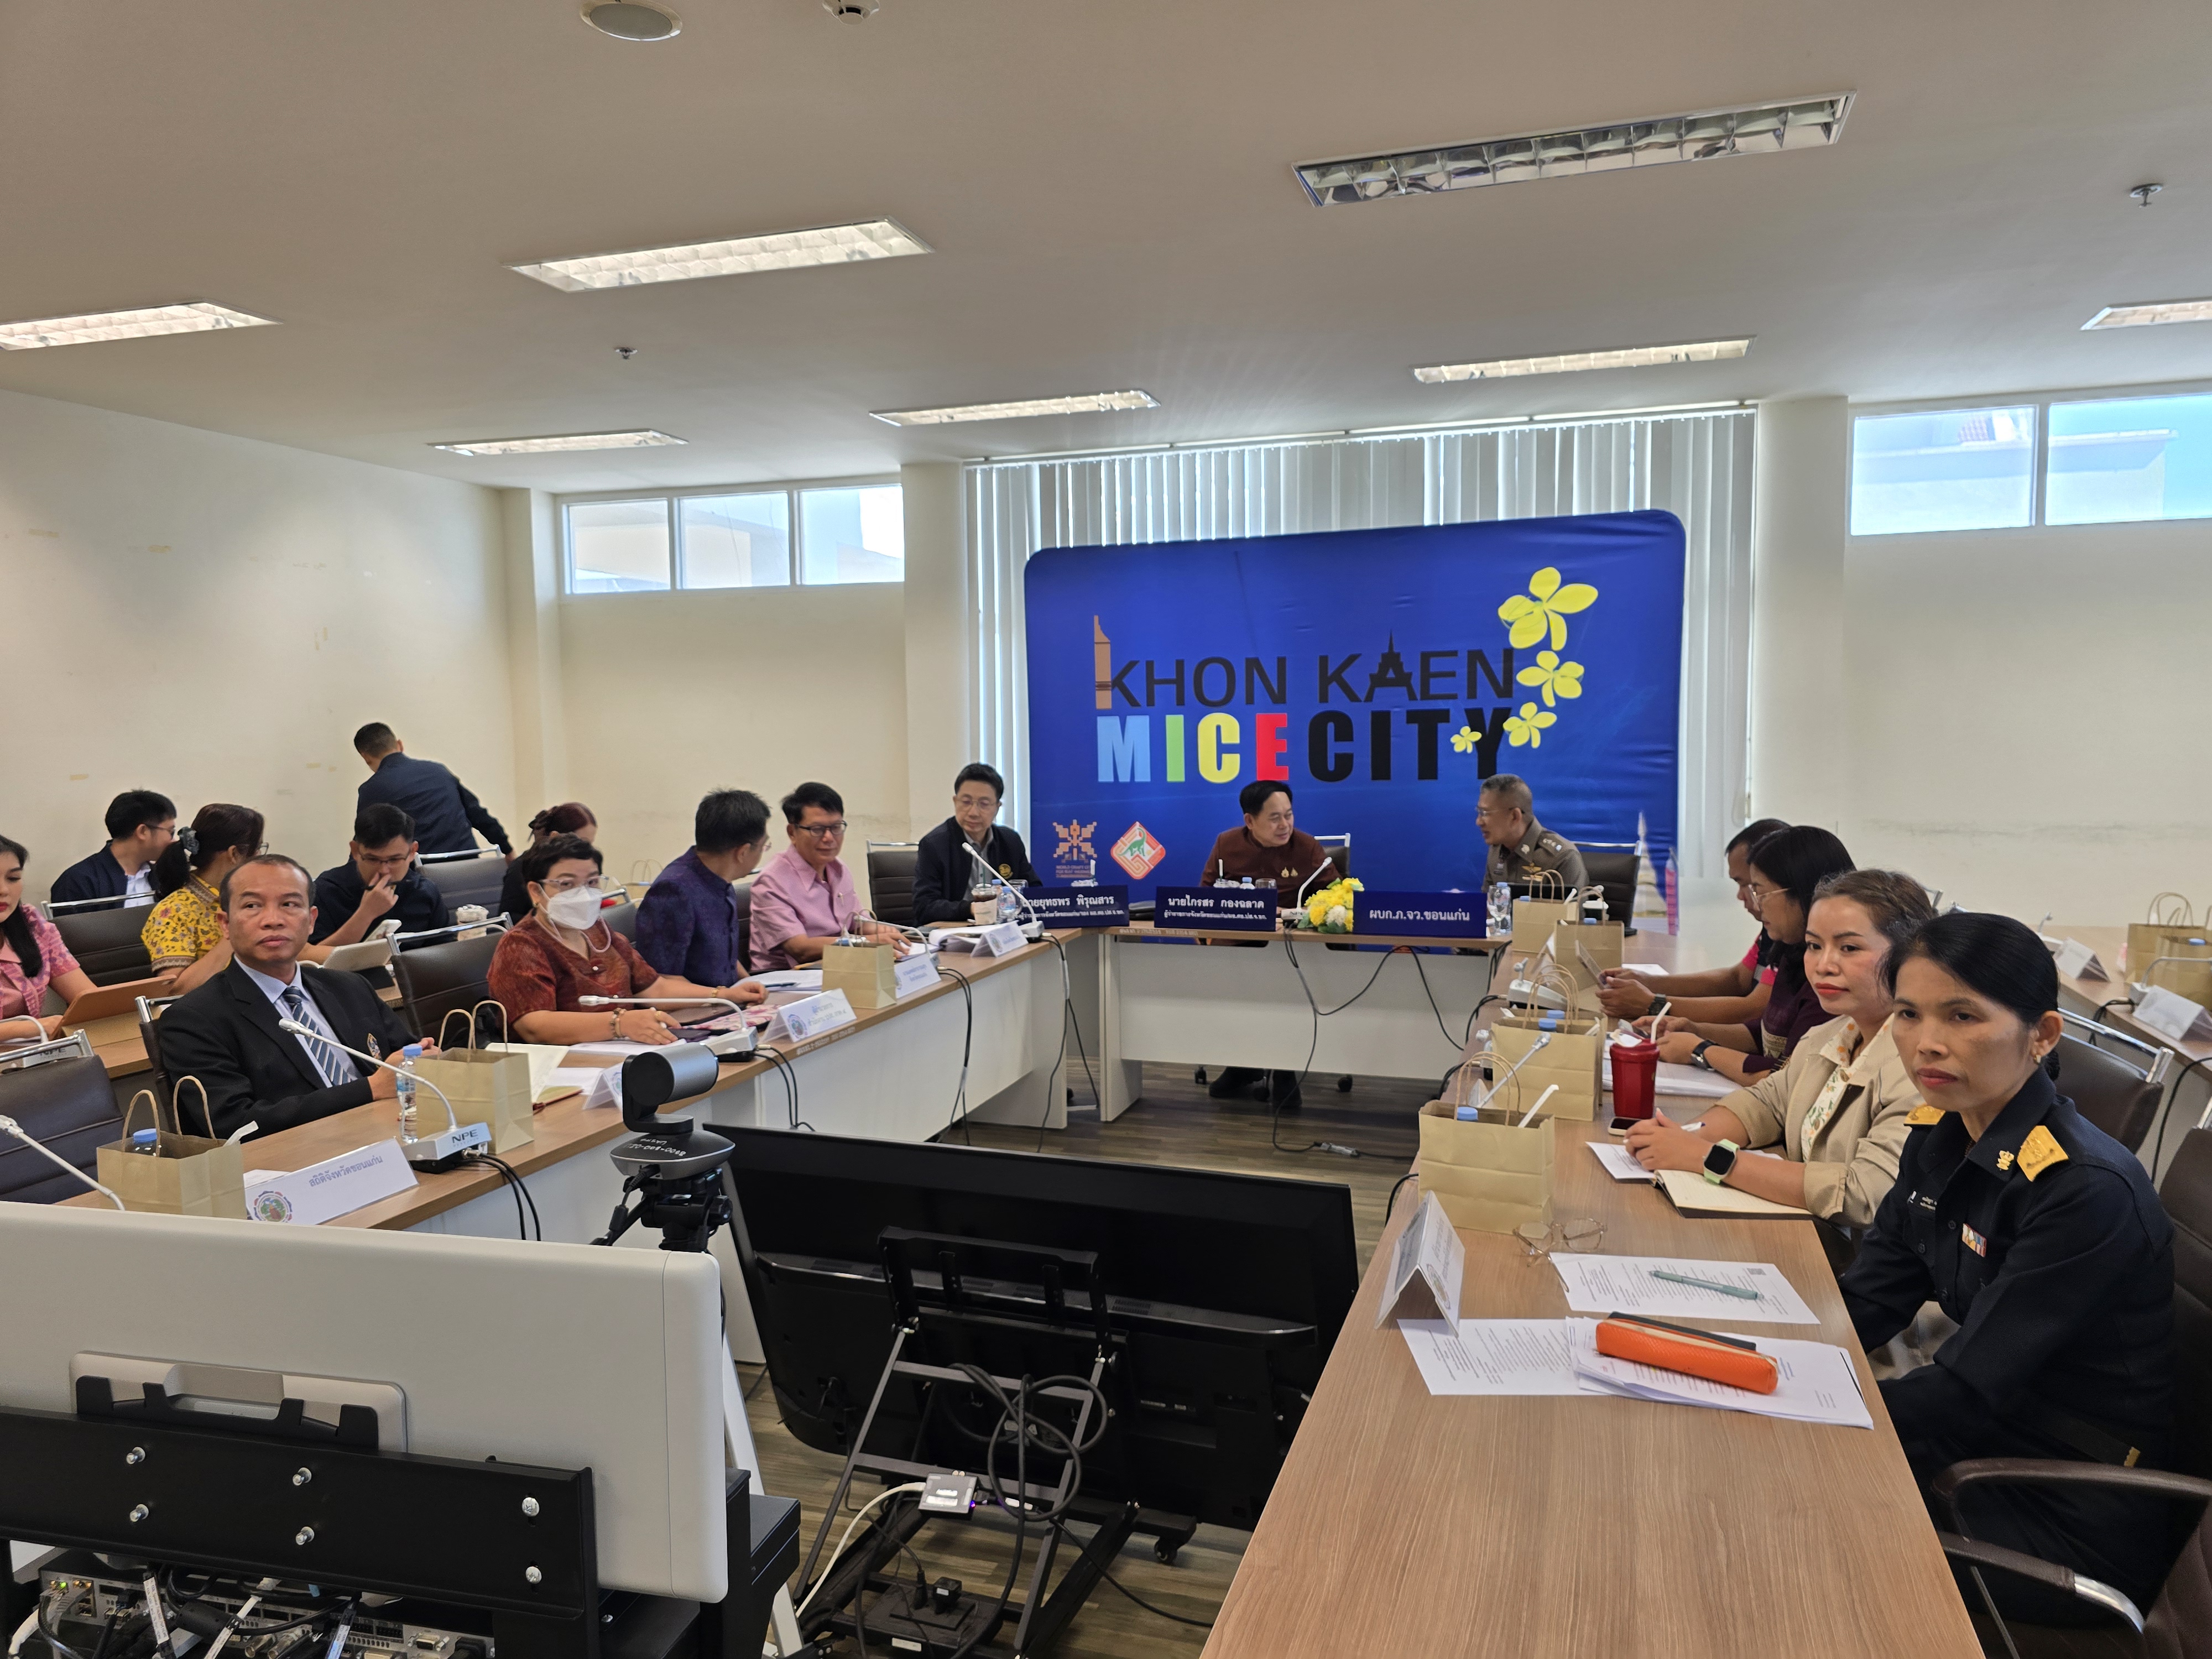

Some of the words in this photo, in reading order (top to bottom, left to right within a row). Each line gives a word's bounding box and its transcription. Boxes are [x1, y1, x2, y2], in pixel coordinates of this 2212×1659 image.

[1094, 641, 1287, 709] KHON
[1318, 629, 1514, 703] KAEN
[1097, 712, 1289, 783] MICE
[1308, 707, 1511, 782] CITY
[1369, 908, 1470, 921] ผบก.ภ.จว.ขอนแก่น
[452, 1129, 478, 1143] NPE
[309, 1154, 383, 1187] สถิติจังหวัดขอนแก่น
